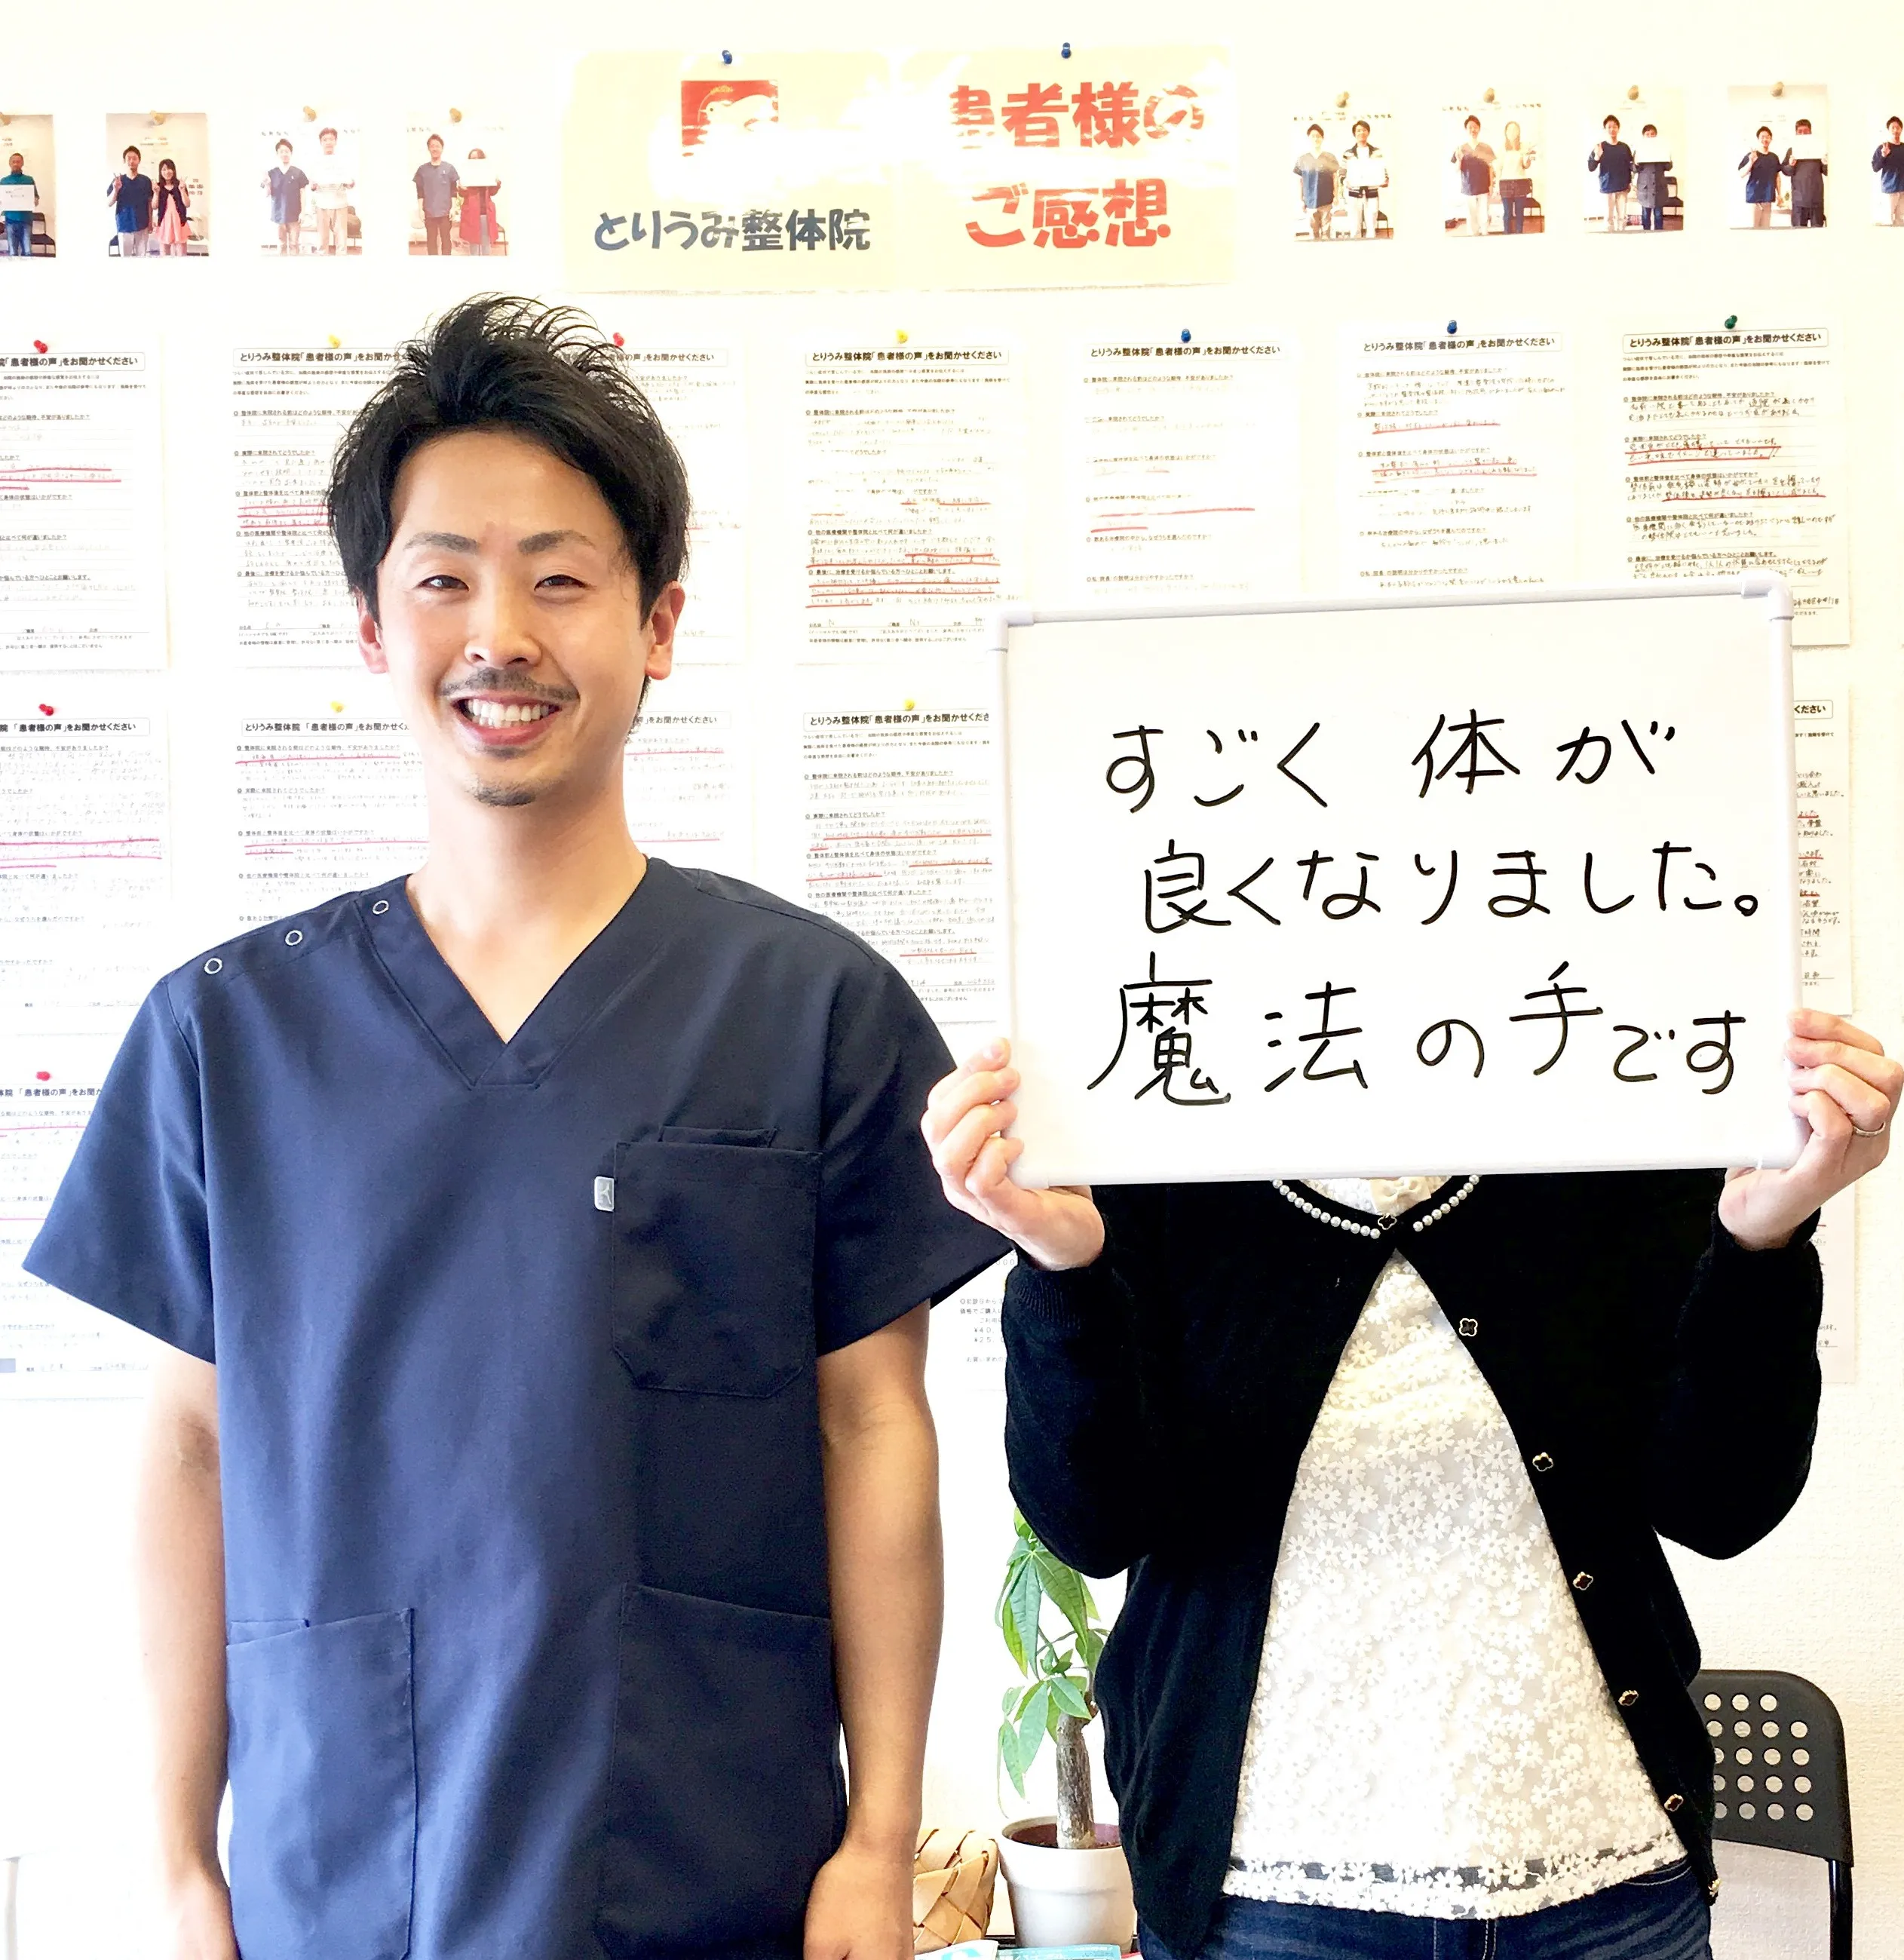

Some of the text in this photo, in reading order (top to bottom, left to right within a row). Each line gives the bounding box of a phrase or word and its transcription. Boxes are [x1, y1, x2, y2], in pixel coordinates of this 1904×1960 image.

[594, 208, 870, 252] とりうみ整体院
[966, 178, 1170, 248] ご感想
[1144, 839, 1758, 934] 良くなりました。
[1087, 950, 1746, 1106] 魔法の手です
